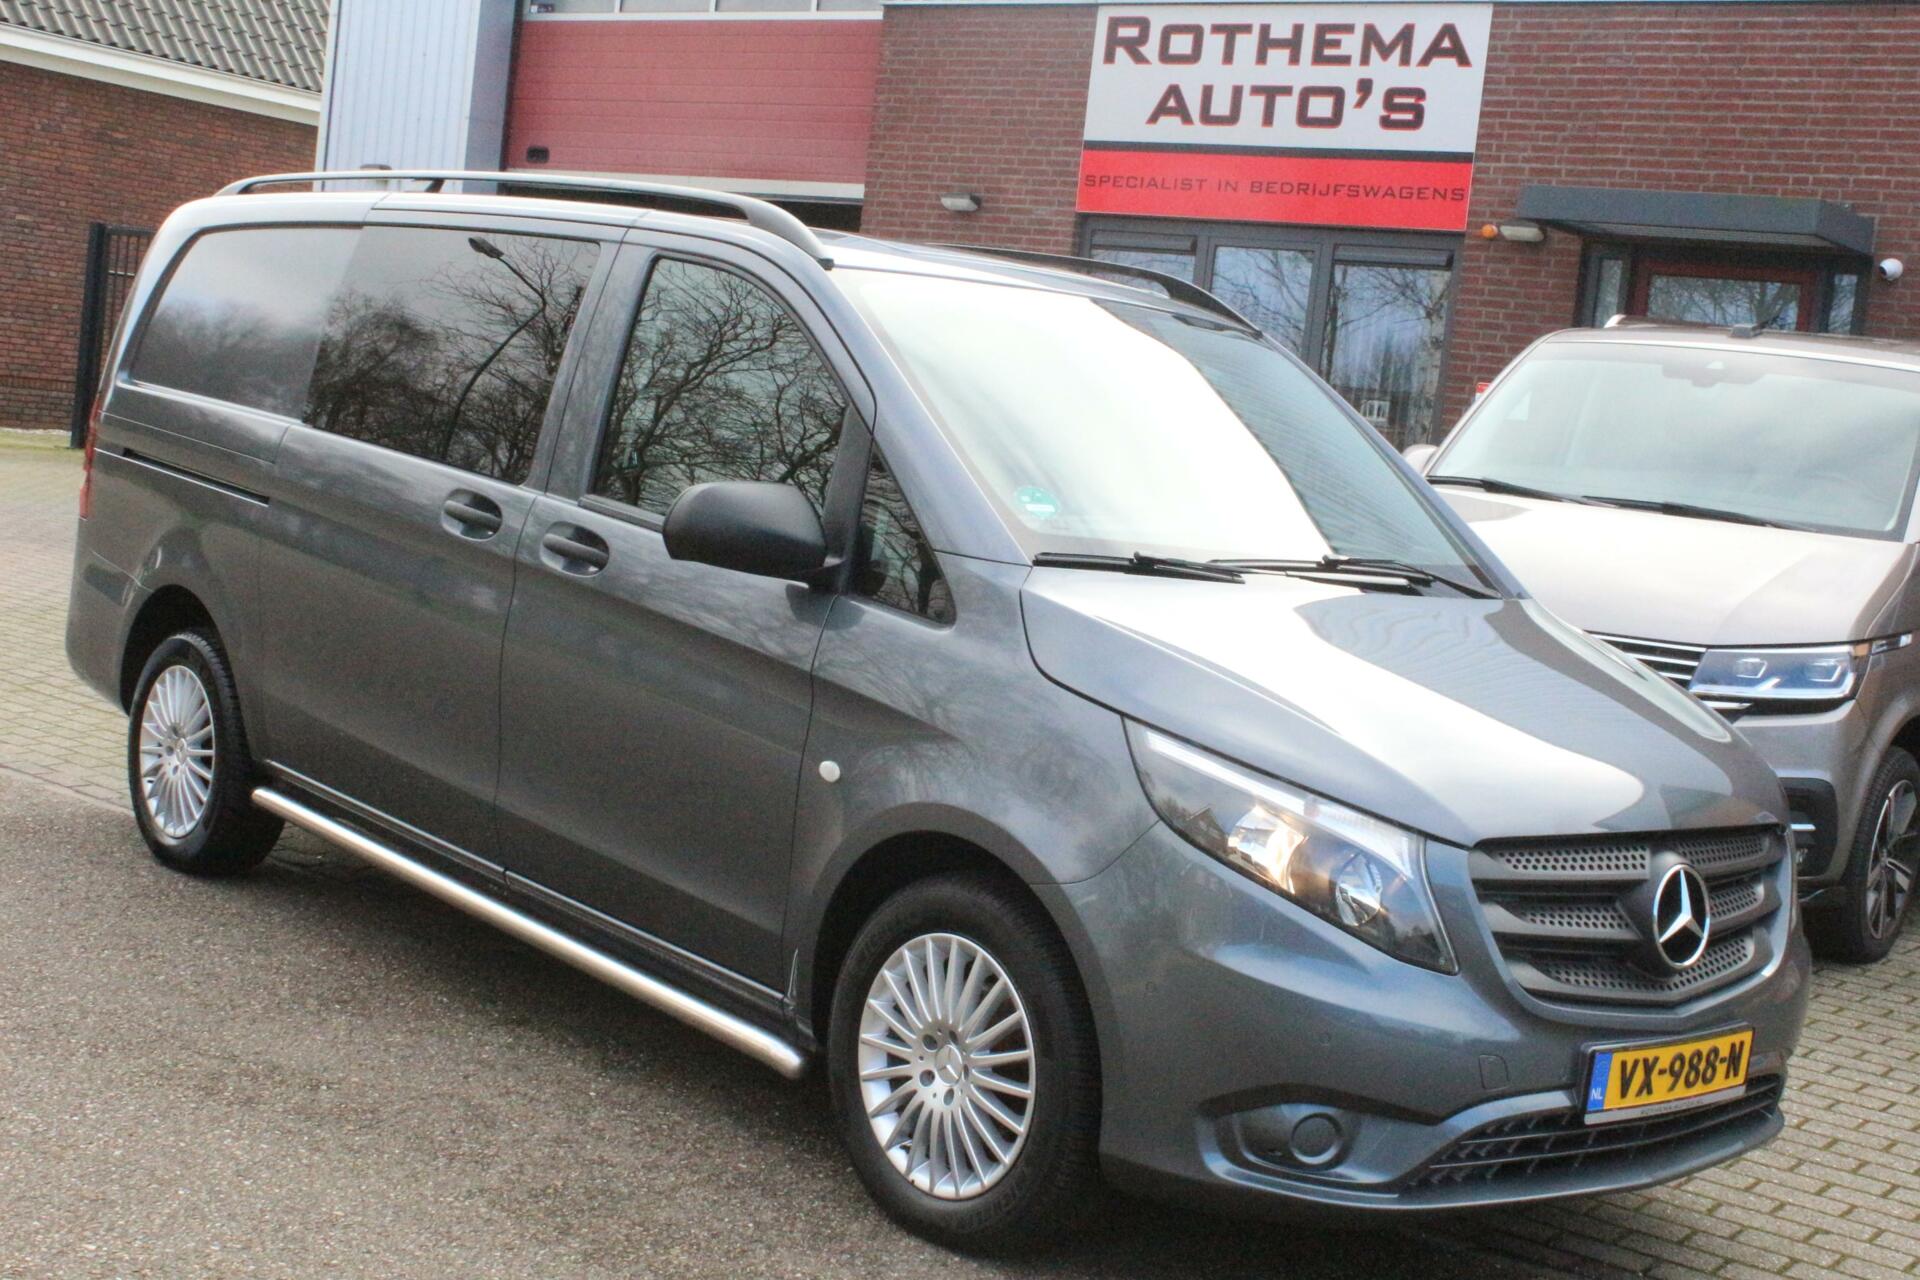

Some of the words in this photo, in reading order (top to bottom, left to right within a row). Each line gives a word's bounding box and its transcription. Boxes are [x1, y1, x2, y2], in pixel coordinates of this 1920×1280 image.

[1103, 16, 1472, 67] ROTHEMA
[1145, 78, 1427, 131] AUTO'S
[1085, 174, 1207, 191] SPECIALIST
[1217, 179, 1239, 192] IN
[1250, 181, 1465, 201] BEDRIJFSWAGENS
[1591, 1087, 1603, 1100] NL
[1620, 1040, 1744, 1099] VX-988-N
